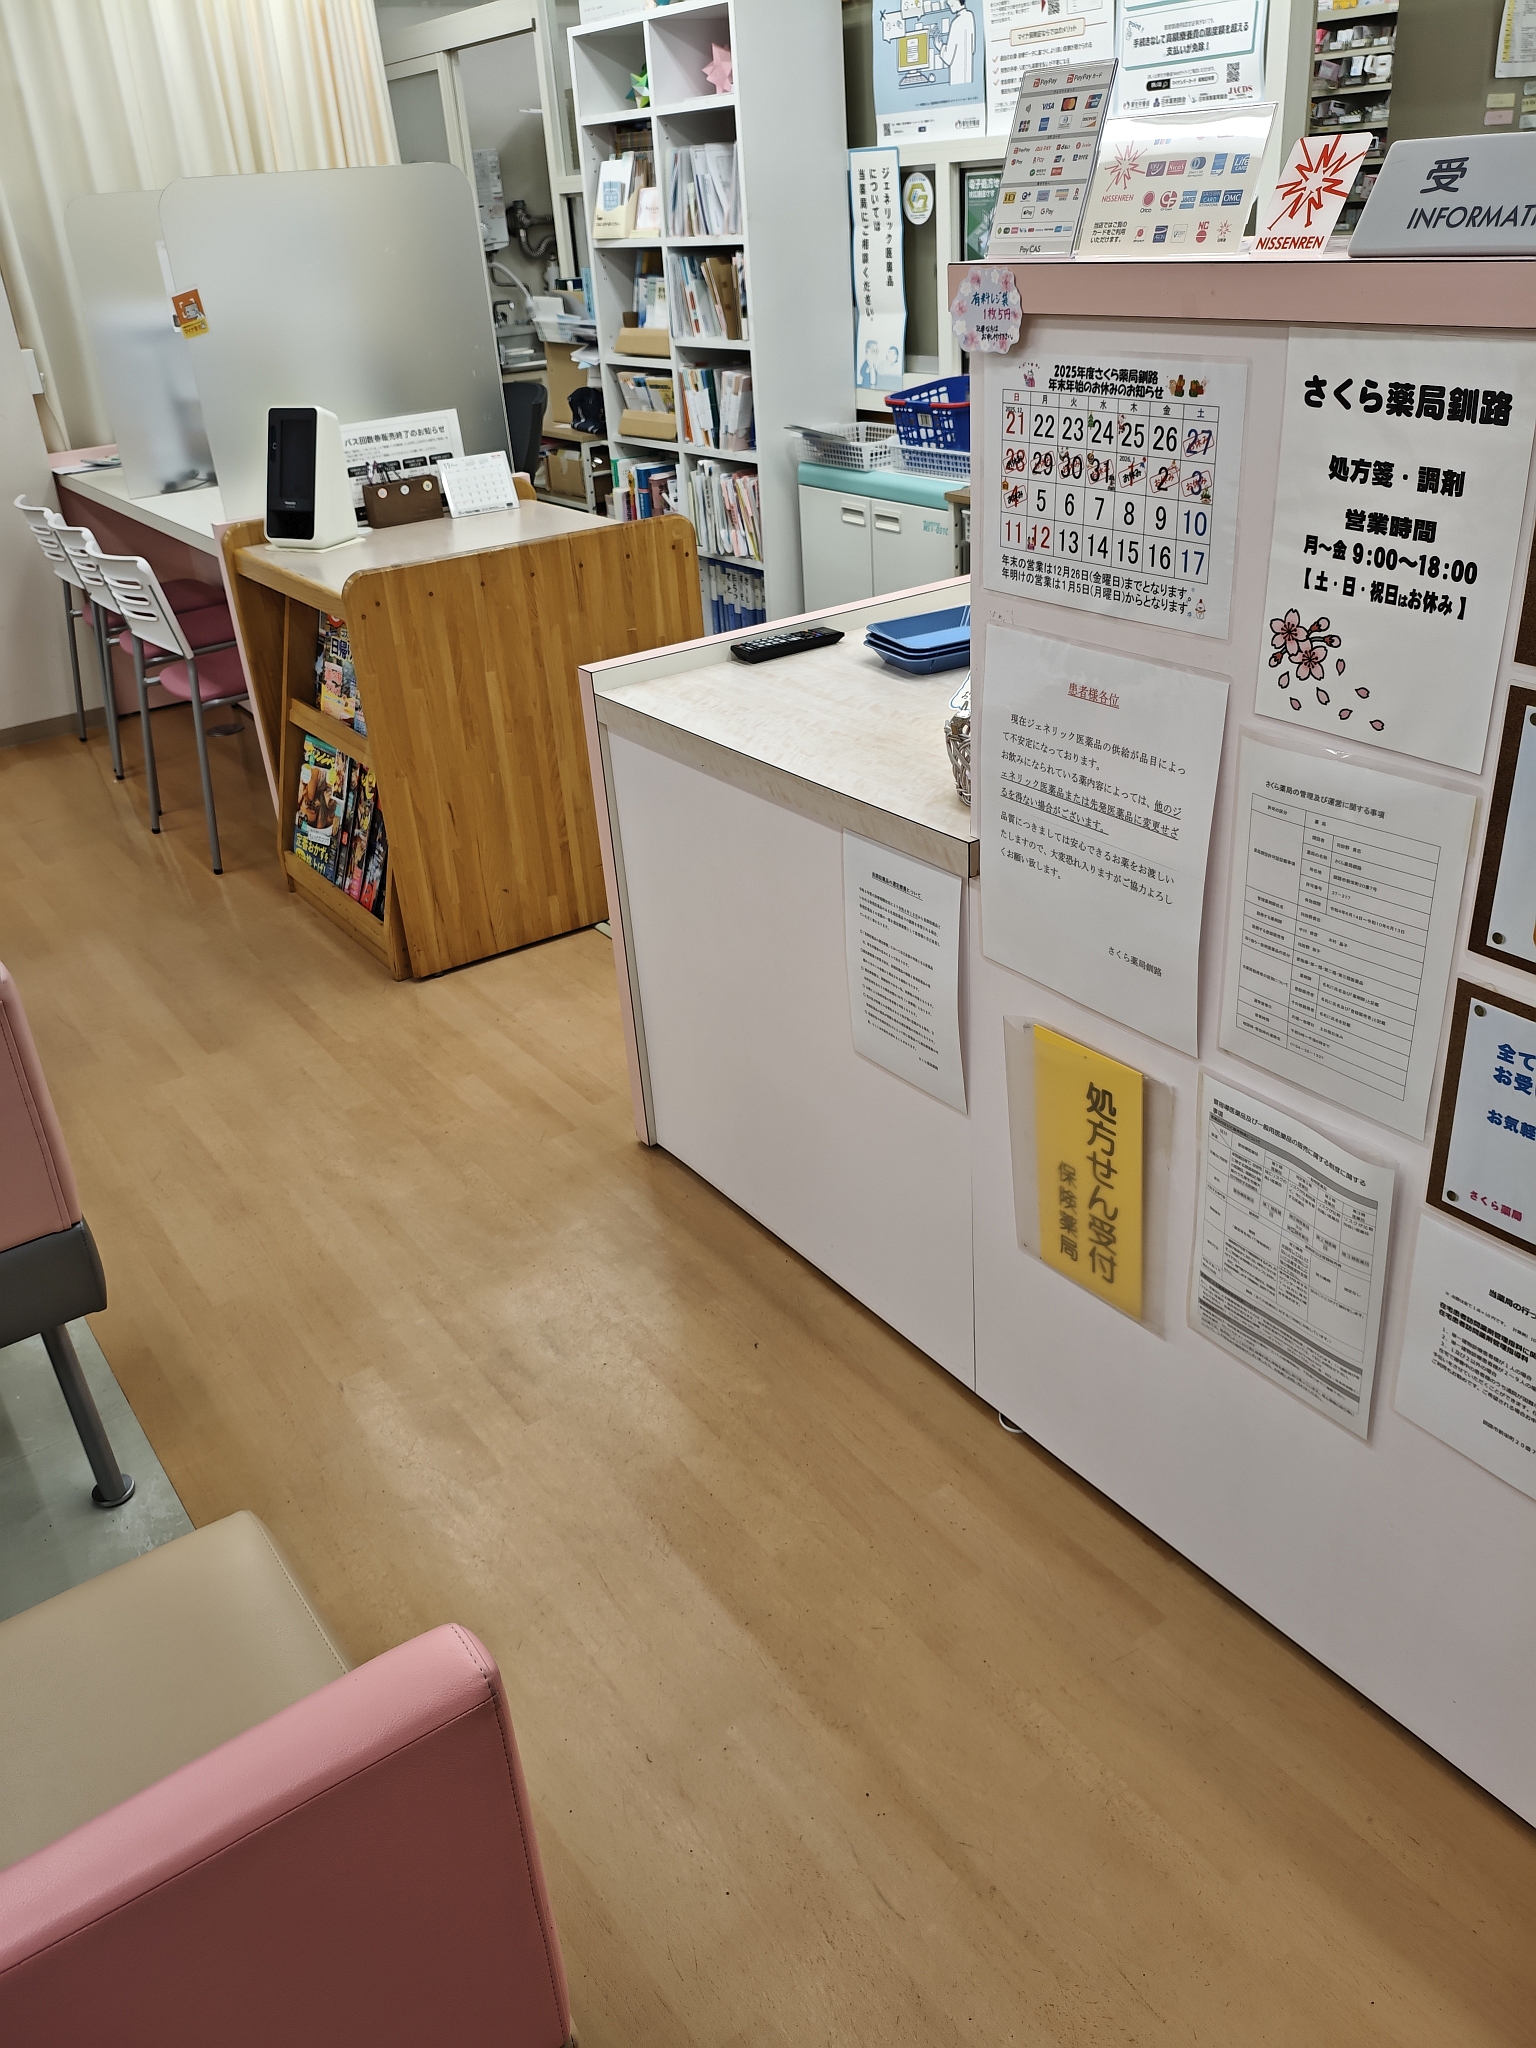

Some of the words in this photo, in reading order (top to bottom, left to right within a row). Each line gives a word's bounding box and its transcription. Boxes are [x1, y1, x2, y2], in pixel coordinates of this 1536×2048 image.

[1040, 78, 1058, 86] PayPay
[1042, 102, 1055, 110] VISA
[1419, 157, 1470, 194] 受
[869, 168, 881, 232] については
[1101, 194, 1134, 203] NISSENREN
[881, 166, 894, 287] ジェネリック医薬品
[1198, 221, 1210, 230] NC
[1255, 236, 1325, 250] NISSENREN
[857, 168, 875, 322] 当薬局にご相談ください。
[971, 291, 1009, 307] 有料レジ袋
[983, 307, 1011, 320] 1枚5円
[1048, 378, 1164, 400] 年末年始のお休みのお知らせ
[1054, 364, 1159, 385] 2025年度さくら薬局釧路
[1014, 393, 1020, 401] 日
[1042, 395, 1048, 405] 月
[1071, 397, 1077, 407] 火
[1099, 400, 1107, 410] 水
[1130, 402, 1138, 412] 木
[1163, 405, 1171, 415] 金
[1197, 408, 1205, 418] 土
[1304, 375, 1513, 426] さくら薬局釧路
[1005, 411, 1024, 435] 21
[1033, 413, 1055, 438] 22
[1062, 416, 1084, 441] 23
[1091, 419, 1114, 445] 24
[1121, 423, 1145, 448] 25
[1152, 425, 1177, 452] 26
[1186, 429, 1213, 455] 27
[1032, 451, 1053, 475] 29
[1060, 455, 1082, 480] 30
[1328, 455, 1466, 497] 処方箋・調剤
[1036, 489, 1047, 512] 5
[1065, 493, 1075, 516] 6
[1094, 497, 1105, 521] 7
[1123, 502, 1135, 526] 8
[1156, 506, 1166, 531] 9
[1183, 510, 1207, 537] 10
[1345, 508, 1437, 543] 営業時間
[1005, 520, 1021, 544] 11
[1031, 524, 1050, 549] 12
[1058, 529, 1079, 554] 13
[1087, 533, 1108, 559] 14
[1117, 539, 1139, 564] 15
[1149, 544, 1171, 570] 16
[1181, 549, 1204, 576] 17
[1352, 542, 1478, 584] 9:00〜18:00
[1001, 554, 1192, 602] 年末の営業は12月26日(金曜日)までとなります。
[1067, 682, 1120, 707] 患者様各位
[1002, 731, 1100, 772] て不安定になっております。
[1010, 713, 1186, 776] 現在ジェネリック医薬品の供給が品目によっ
[1001, 750, 1182, 817] お飲みになられている薬内容によっては、他のジ
[1265, 780, 1385, 819] さくら薬局の管理及び運営に関する事項
[1001, 769, 1179, 839] ェネリック医薬品または先発医薬品に変更せざ
[1001, 787, 1106, 833] るを得ない場合がございます。
[1000, 811, 1175, 885] 品質につきましては安心できるお薬をお渡しい
[1000, 847, 1061, 880] くお願い致します。
[1000, 828, 1172, 905] たしますので、大変恐れ入りますがご協力よろし
[1108, 946, 1163, 977] さくら薬局釧路
[1497, 1044, 1536, 1072] 全て
[1493, 1066, 1536, 1097] お受
[1487, 1109, 1536, 1141] お気軽
[1085, 1081, 1118, 1284] 処方せん受付
[1058, 1160, 1078, 1263] 保険薬局
[1470, 1191, 1523, 1222] さくら薬局
